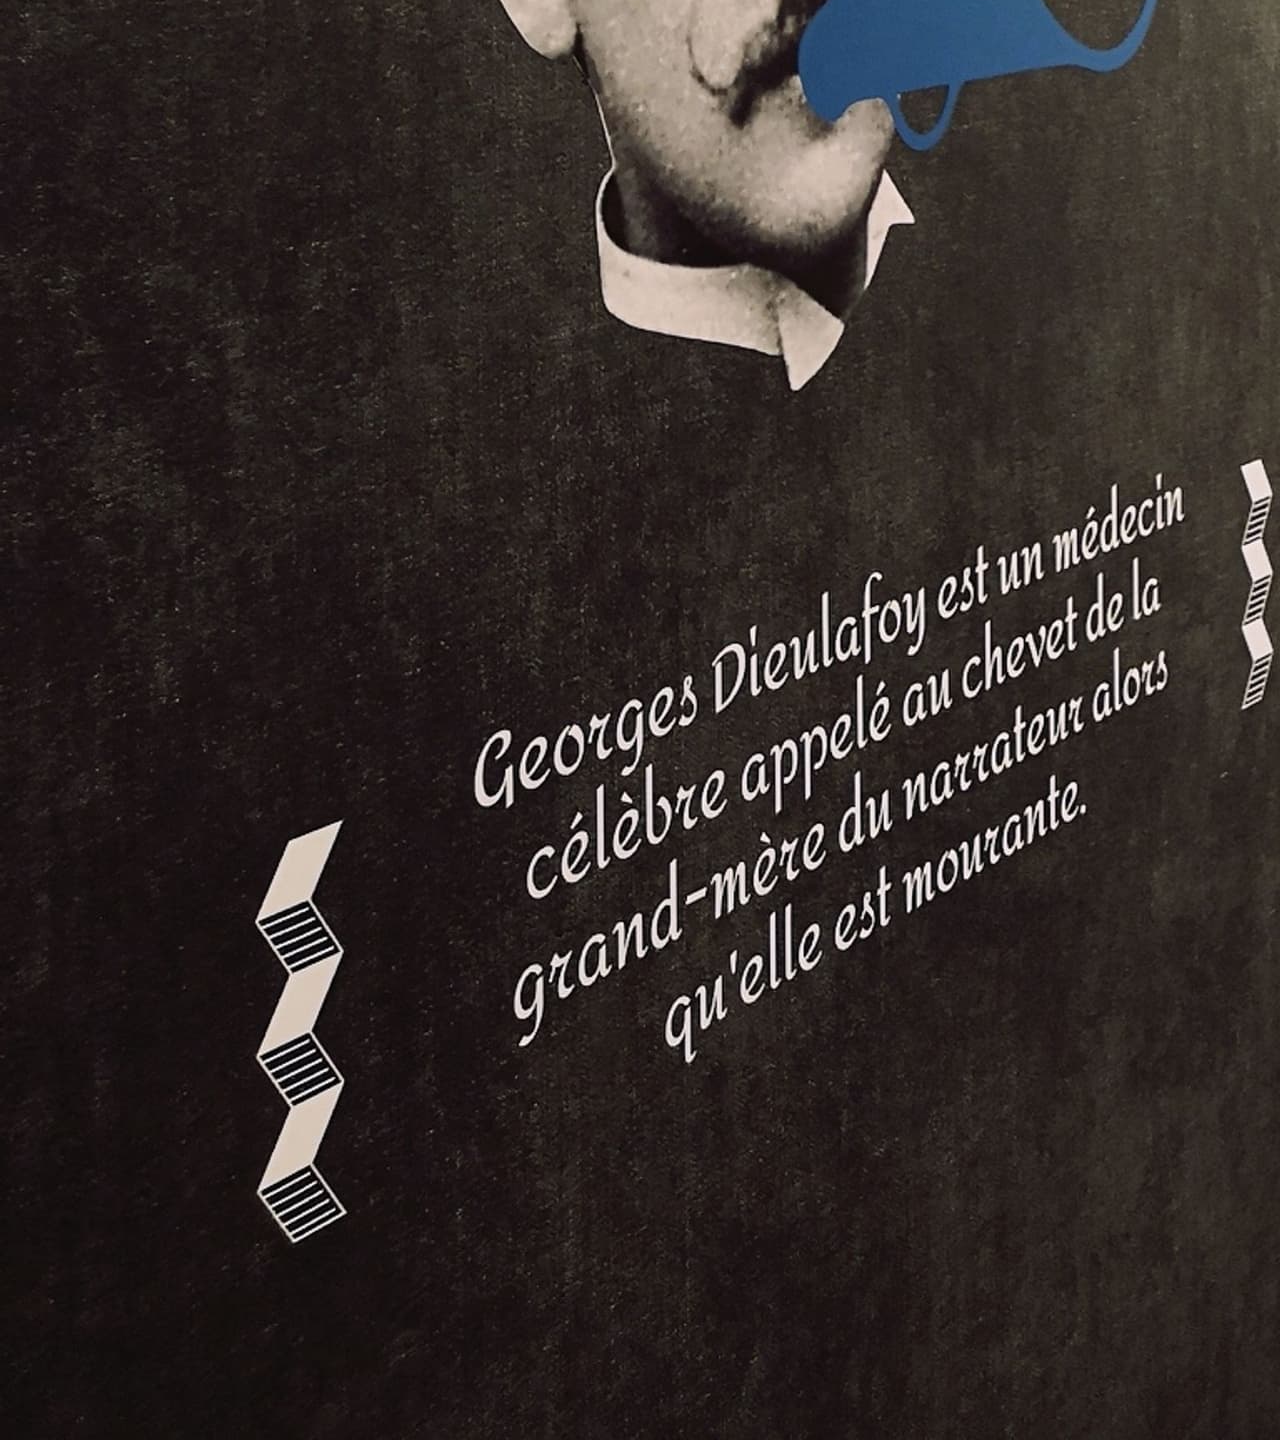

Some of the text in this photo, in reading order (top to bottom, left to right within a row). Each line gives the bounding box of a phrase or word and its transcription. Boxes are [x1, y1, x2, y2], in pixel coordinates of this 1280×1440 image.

[473, 472, 1186, 809] Georges Dieulafoy est un médecin
[525, 556, 1162, 899] célèbre appelé au chevet de la
[512, 647, 1169, 1047] grand-mère du narrateur alors
[664, 774, 1088, 1064] qu'elle est mourante.
